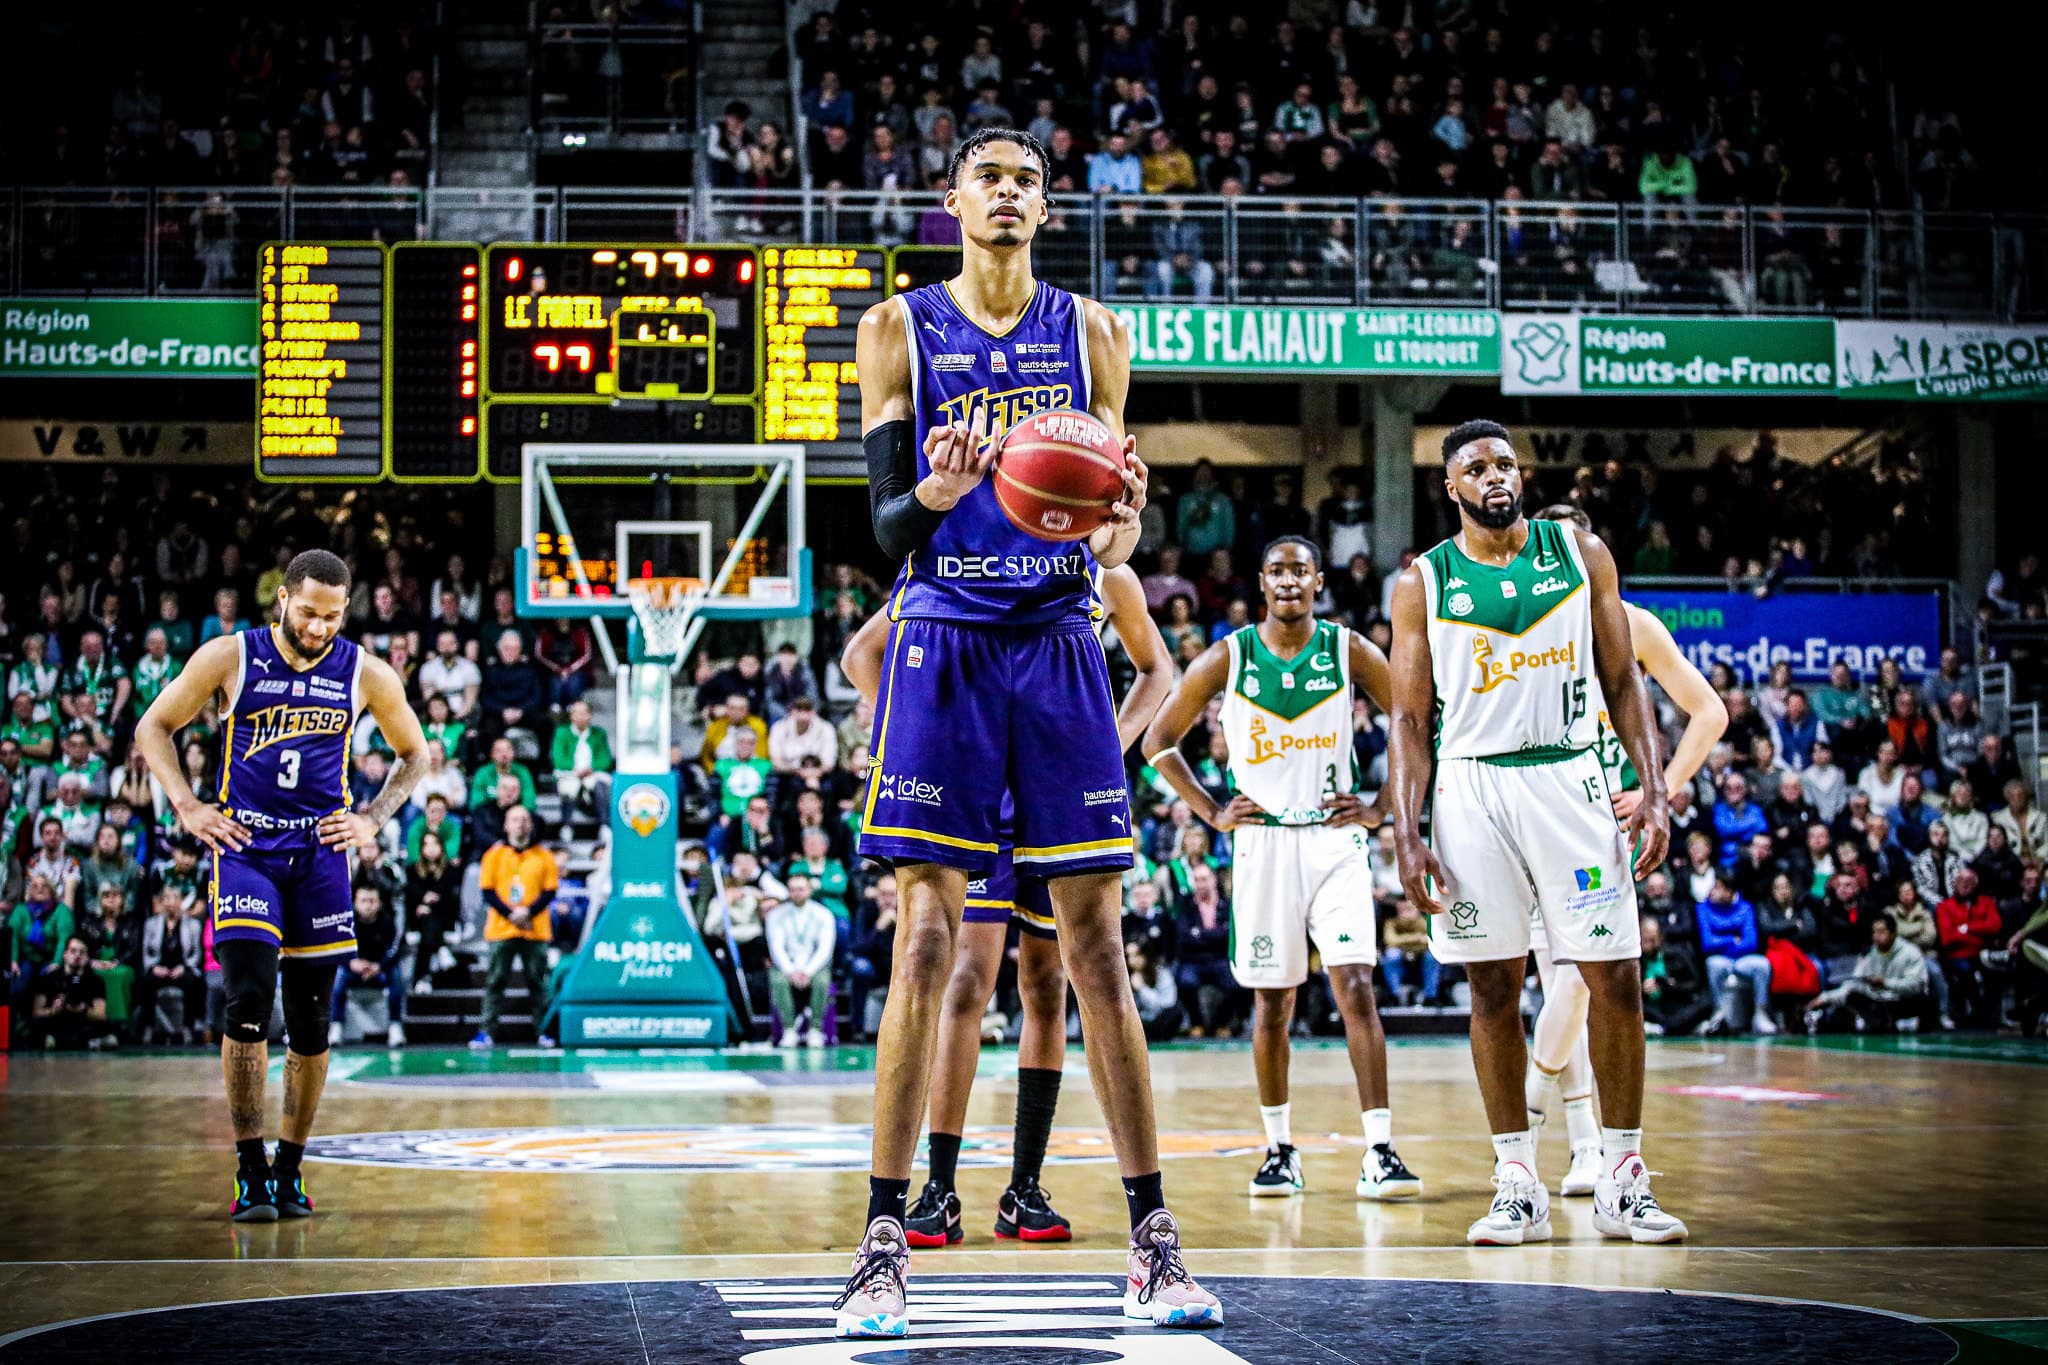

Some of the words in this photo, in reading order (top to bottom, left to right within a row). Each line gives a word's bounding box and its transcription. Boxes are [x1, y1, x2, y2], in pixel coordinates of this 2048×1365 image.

[5, 309, 90, 335] Région
[1356, 312, 1496, 338] SAINT-LEONARD
[1204, 308, 1347, 365] FLAHAUT
[1584, 326, 1666, 354] Région
[1375, 341, 1394, 364] LE
[1400, 341, 1479, 366] TOUQUET
[1584, 355, 1832, 386] Hauts-de-France
[34, 427, 62, 455] V
[73, 427, 104, 455] &
[117, 427, 161, 456] W
[937, 556, 999, 578] IDEC
[1005, 555, 1080, 576] SPORT
[1680, 636, 1927, 675] uts-de-France
[1562, 677, 1587, 726] 15
[249, 705, 346, 751] METS92
[277, 749, 301, 789] 3
[1322, 763, 1337, 793] 3
[897, 775, 943, 801] idex
[1582, 775, 1602, 803] 15
[237, 809, 274, 829] IDEC
[235, 895, 269, 911] idex
